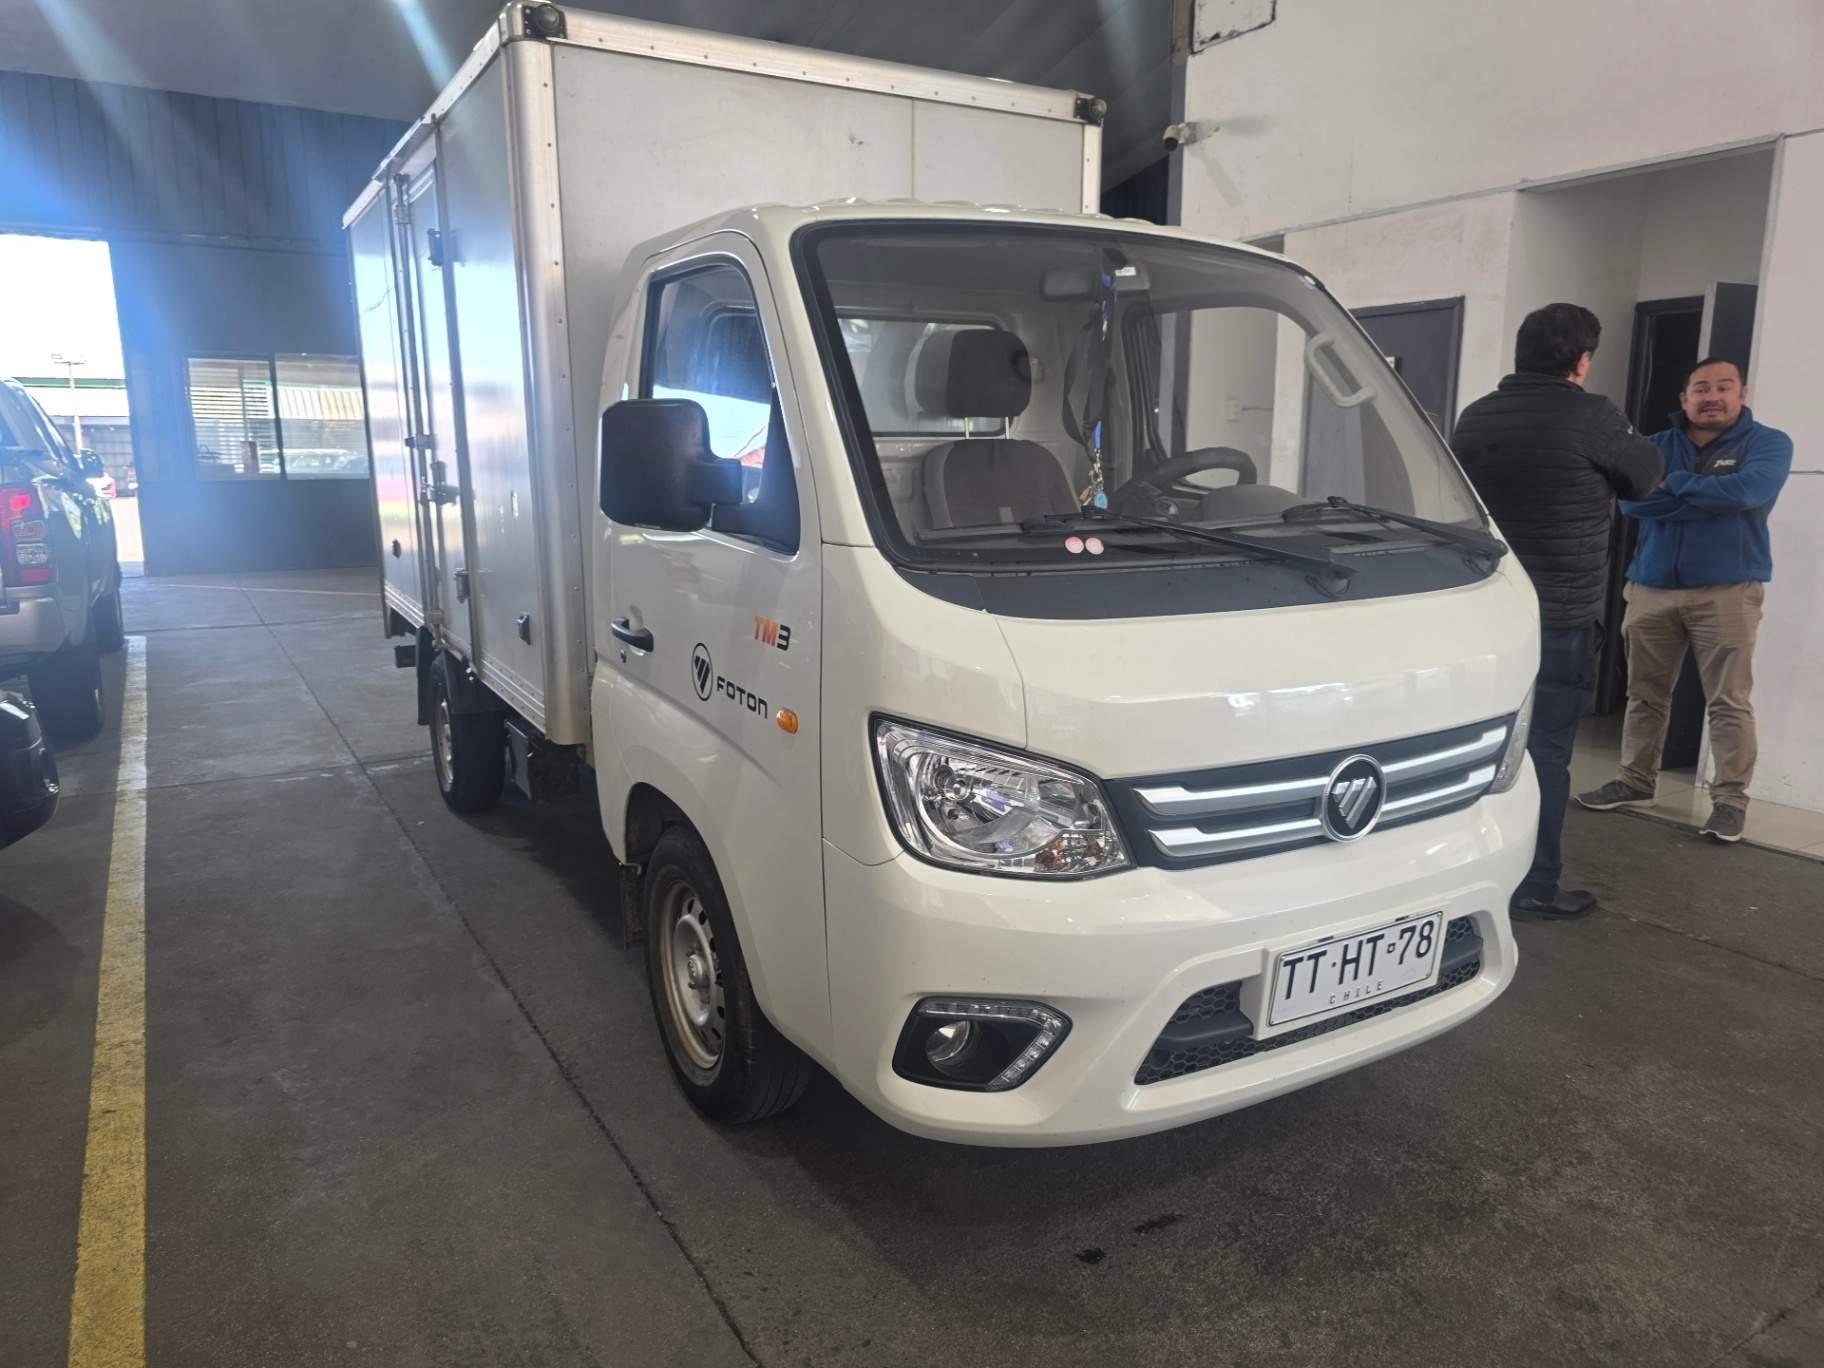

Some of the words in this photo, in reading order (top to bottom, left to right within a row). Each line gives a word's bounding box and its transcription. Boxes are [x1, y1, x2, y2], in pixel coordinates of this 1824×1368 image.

[753, 615, 792, 651] TM3
[716, 675, 768, 720] FOTON
[1328, 981, 1383, 1005] CHILE
